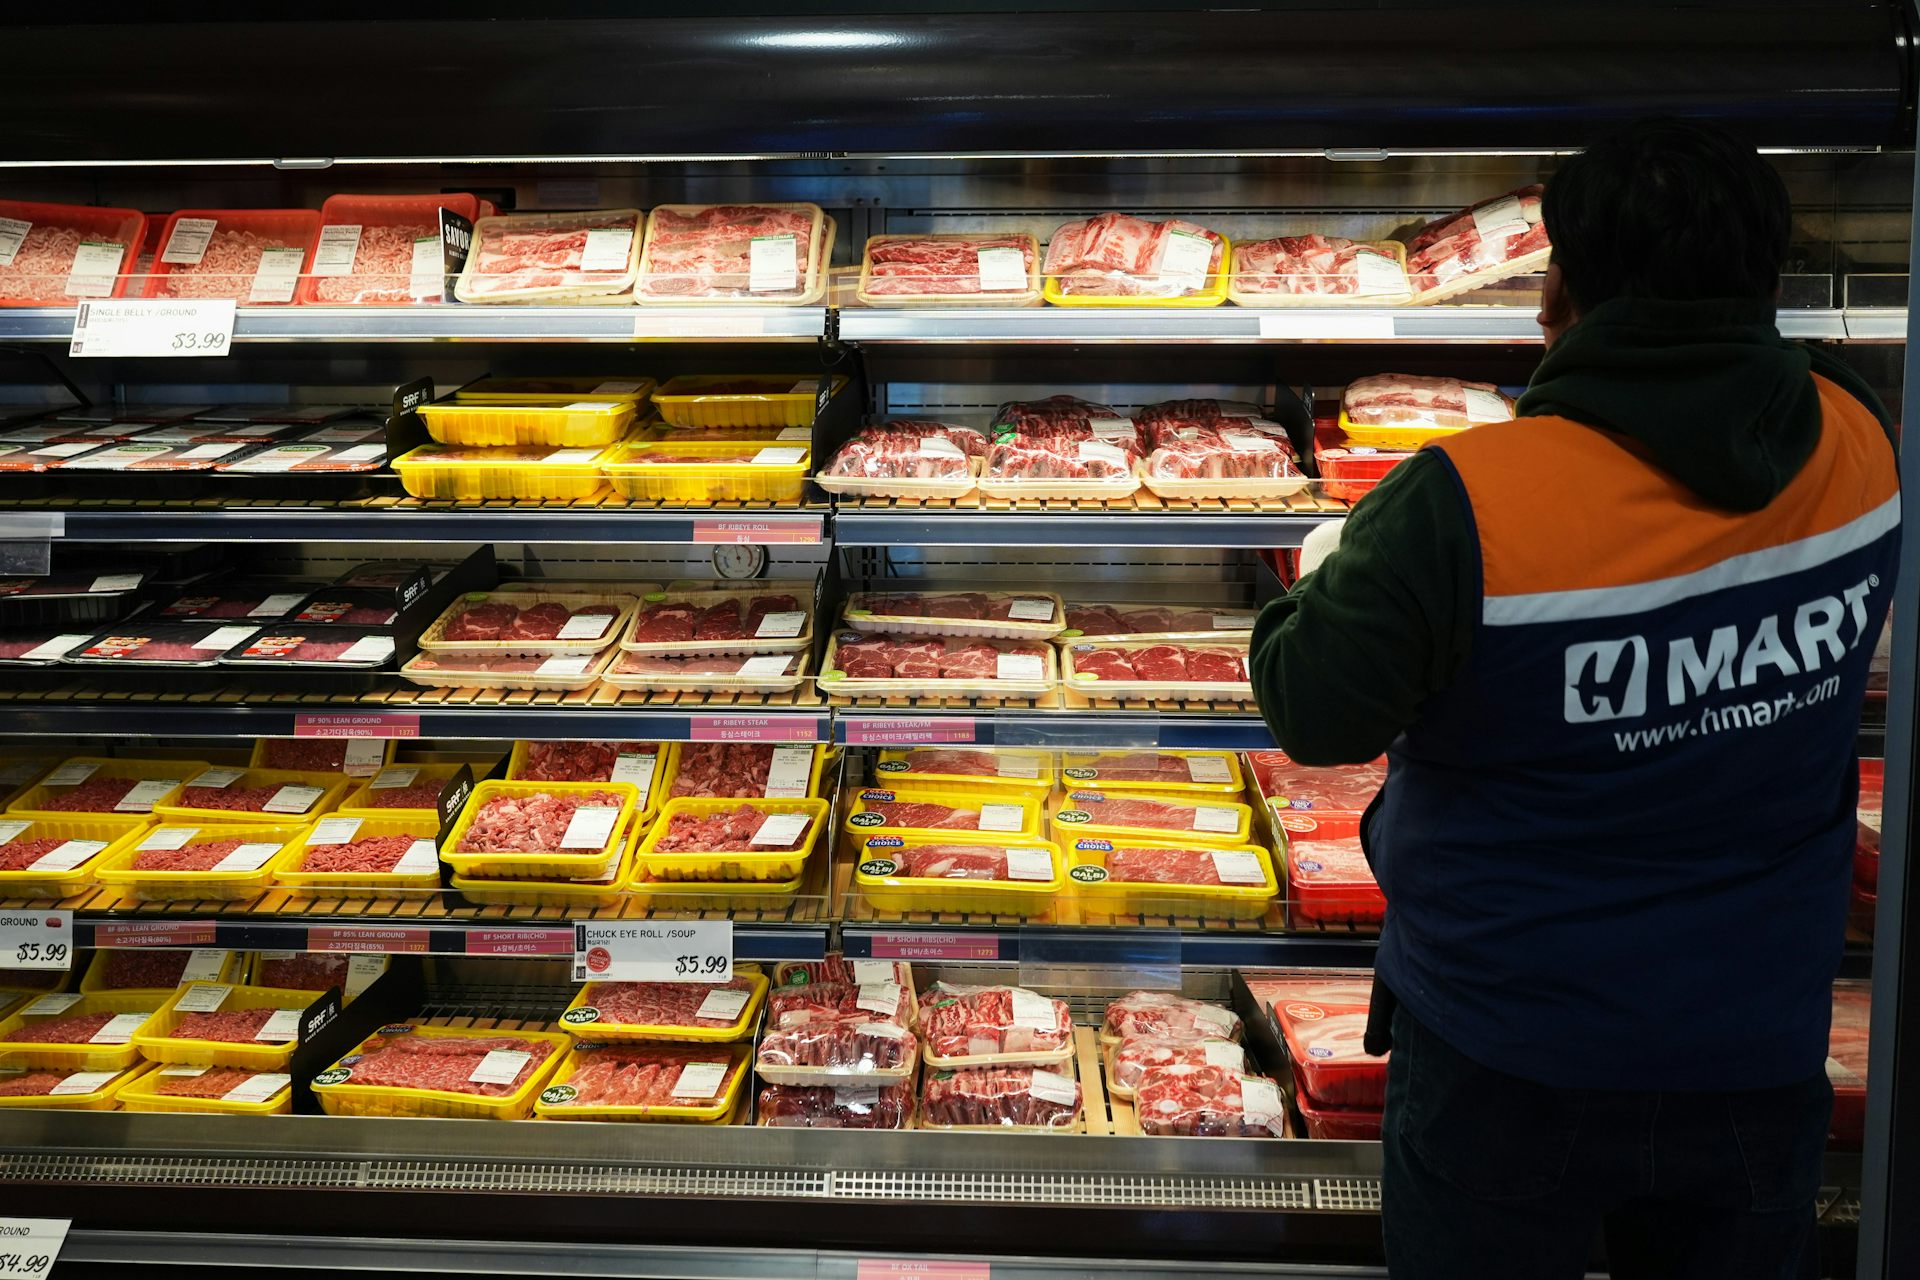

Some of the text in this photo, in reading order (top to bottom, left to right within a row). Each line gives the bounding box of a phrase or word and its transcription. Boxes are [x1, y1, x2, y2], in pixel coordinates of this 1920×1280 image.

[90, 309, 121, 317] SINGLE
[172, 332, 226, 350] $3.99
[1613, 674, 1841, 752] www.hmart.om
[713, 719, 722, 727] BF
[724, 719, 746, 727] RIBEYE
[862, 720, 932, 729] BF RIBEYE STEAK/FM
[720, 730, 761, 739] 등심스테이크
[861, 865, 893, 873] GALBI
[1072, 871, 1104, 879] GALBI
[0, 917, 39, 927] GROUND
[377, 931, 406, 939] GROUND
[493, 933, 515, 941] SHORT
[516, 932, 547, 941] RIB(CHO)
[586, 929, 697, 938] CHUCK EYE ROLL /SOUP
[16, 942, 68, 963] $5.99
[675, 954, 728, 976] $5.99
[565, 1012, 596, 1020] GALBI
[308, 1009, 326, 1033] SRF
[0, 1253, 49, 1273] $4.99
